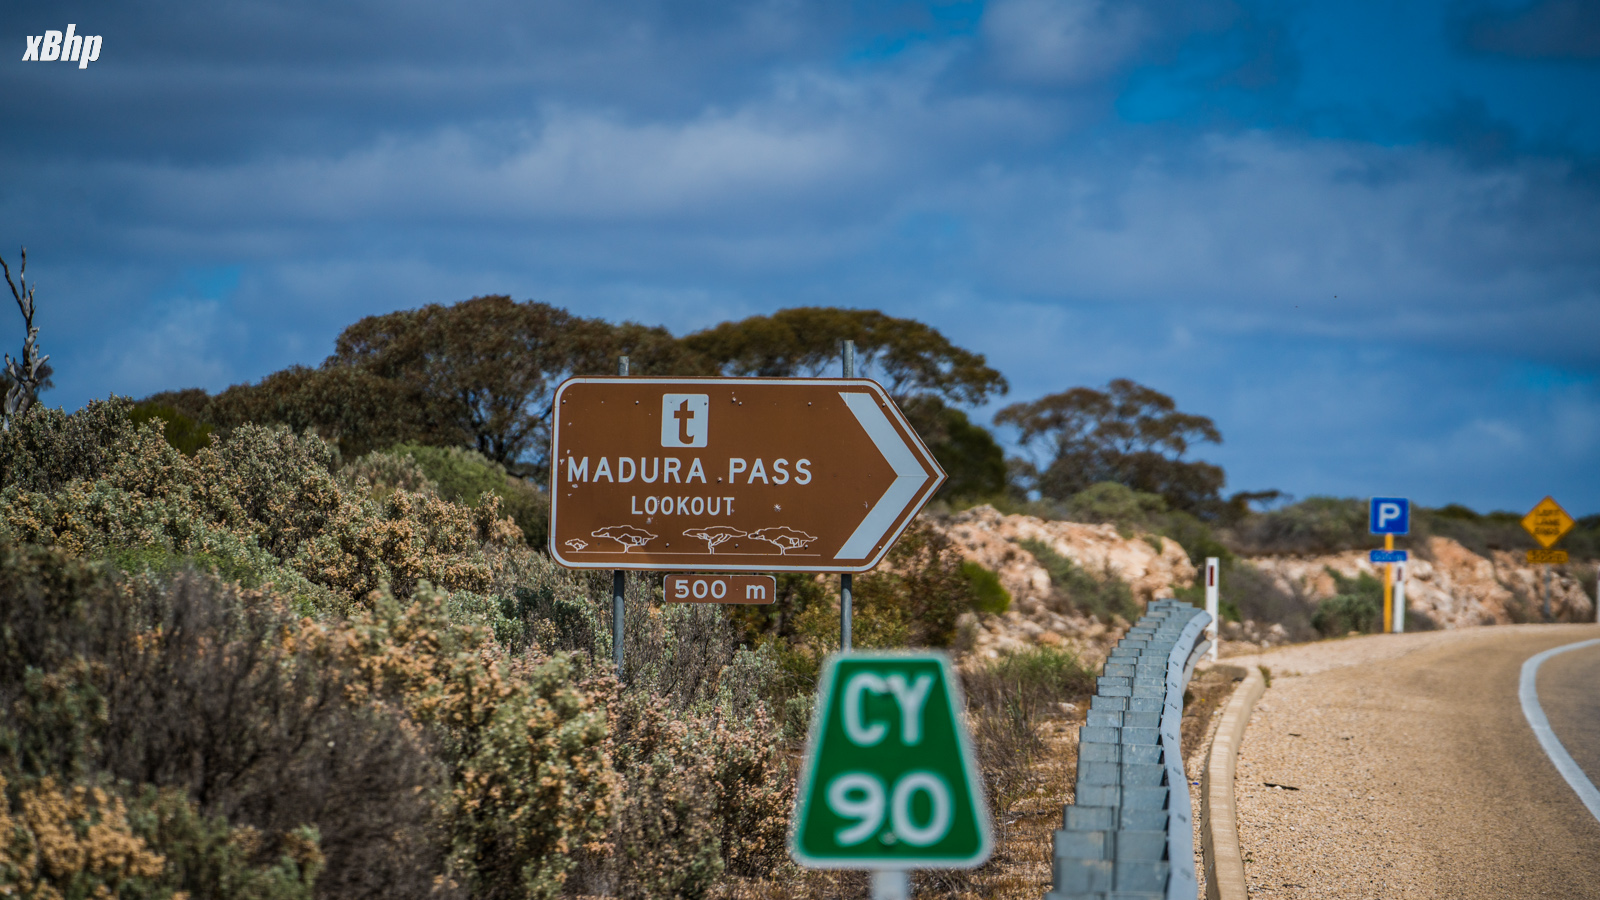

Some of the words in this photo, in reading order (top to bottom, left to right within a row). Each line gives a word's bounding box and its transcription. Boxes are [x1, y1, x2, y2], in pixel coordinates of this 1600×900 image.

[566, 456, 708, 484] MADURA
[728, 457, 813, 485] PASS
[631, 496, 735, 516] LOOKOUT
[1379, 503, 1401, 528] P
[675, 579, 727, 599] 500
[745, 583, 766, 599] m
[842, 672, 936, 747] CY
[826, 771, 955, 847] 90
